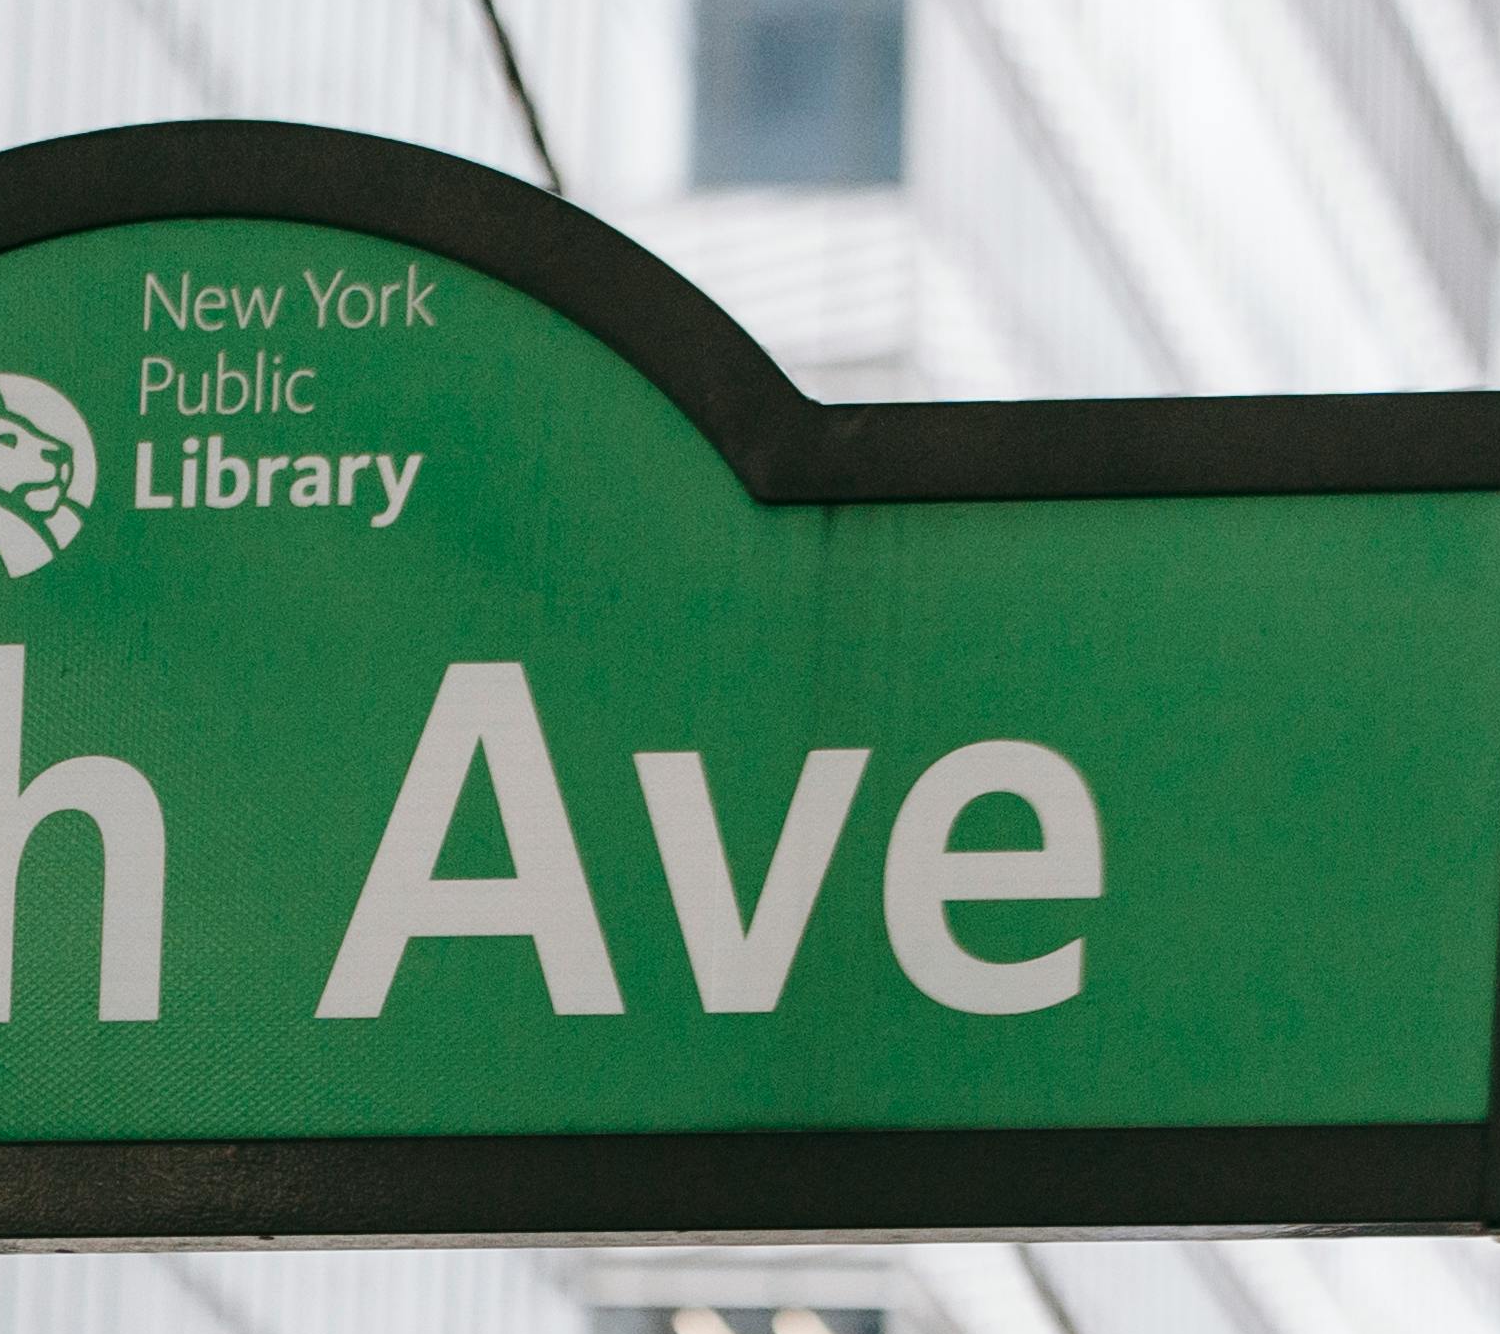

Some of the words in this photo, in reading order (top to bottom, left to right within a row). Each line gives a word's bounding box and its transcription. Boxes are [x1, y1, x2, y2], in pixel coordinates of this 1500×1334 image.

[142, 272, 284, 332] New
[303, 264, 437, 329] York
[139, 350, 316, 417] Public
[134, 435, 424, 528] Library
[313, 661, 1104, 1019] Ave
